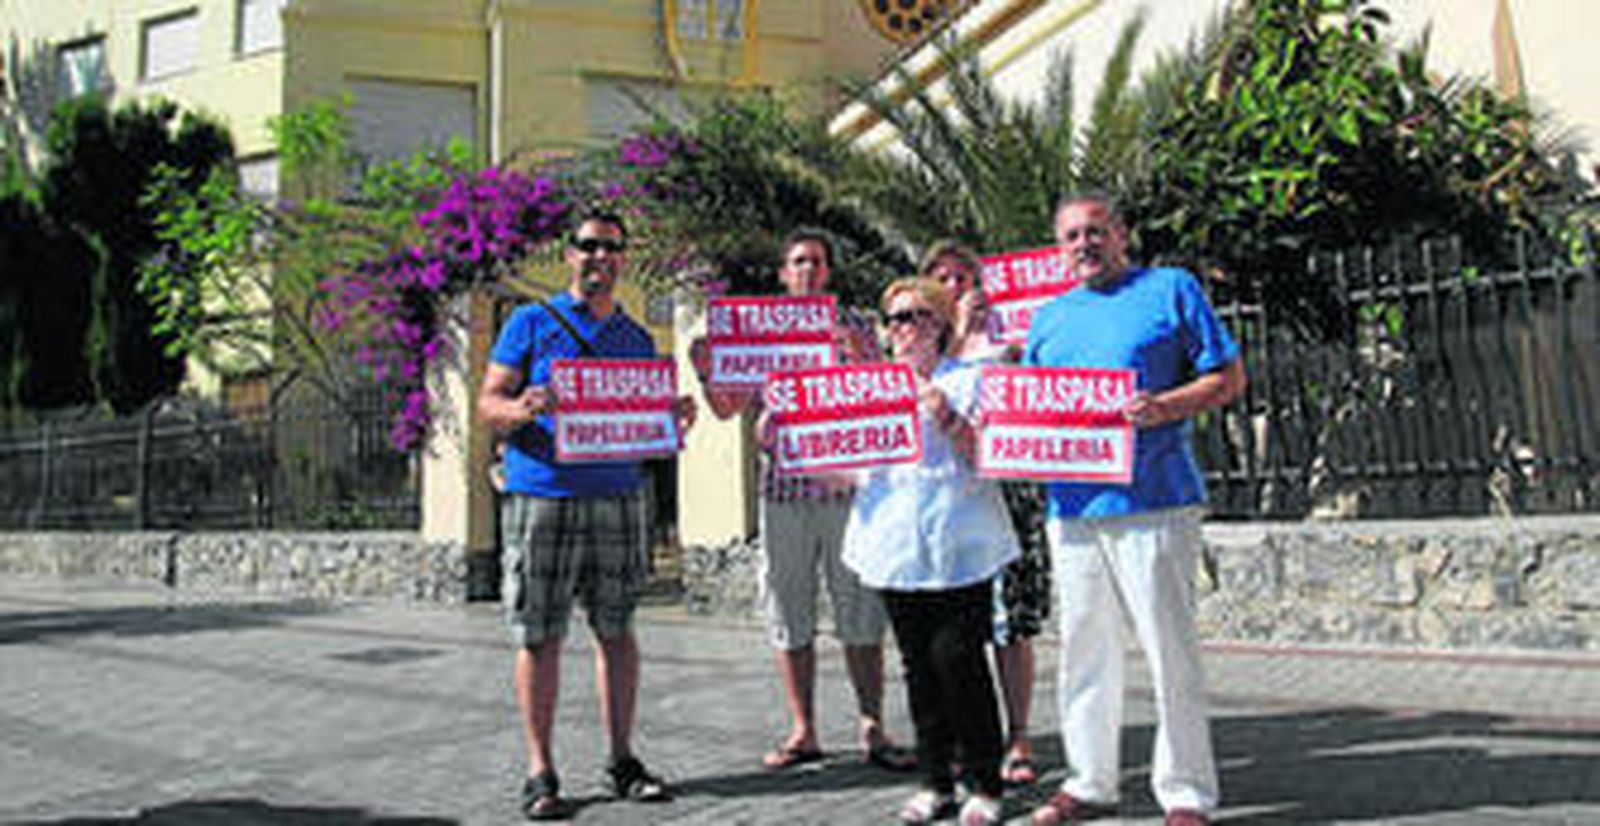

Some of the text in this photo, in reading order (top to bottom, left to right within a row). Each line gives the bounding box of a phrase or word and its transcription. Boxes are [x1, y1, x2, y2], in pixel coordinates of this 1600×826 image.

[980, 260, 1006, 292] SE
[738, 304, 832, 335] TRASPASA
[553, 367, 677, 399] SE TRASPASA
[766, 370, 914, 412] SE TRASPASA
[981, 375, 1129, 412] SE TRASPASA
[781, 424, 912, 460] LIBRERIA
[991, 436, 1115, 462] PAPELERIA
